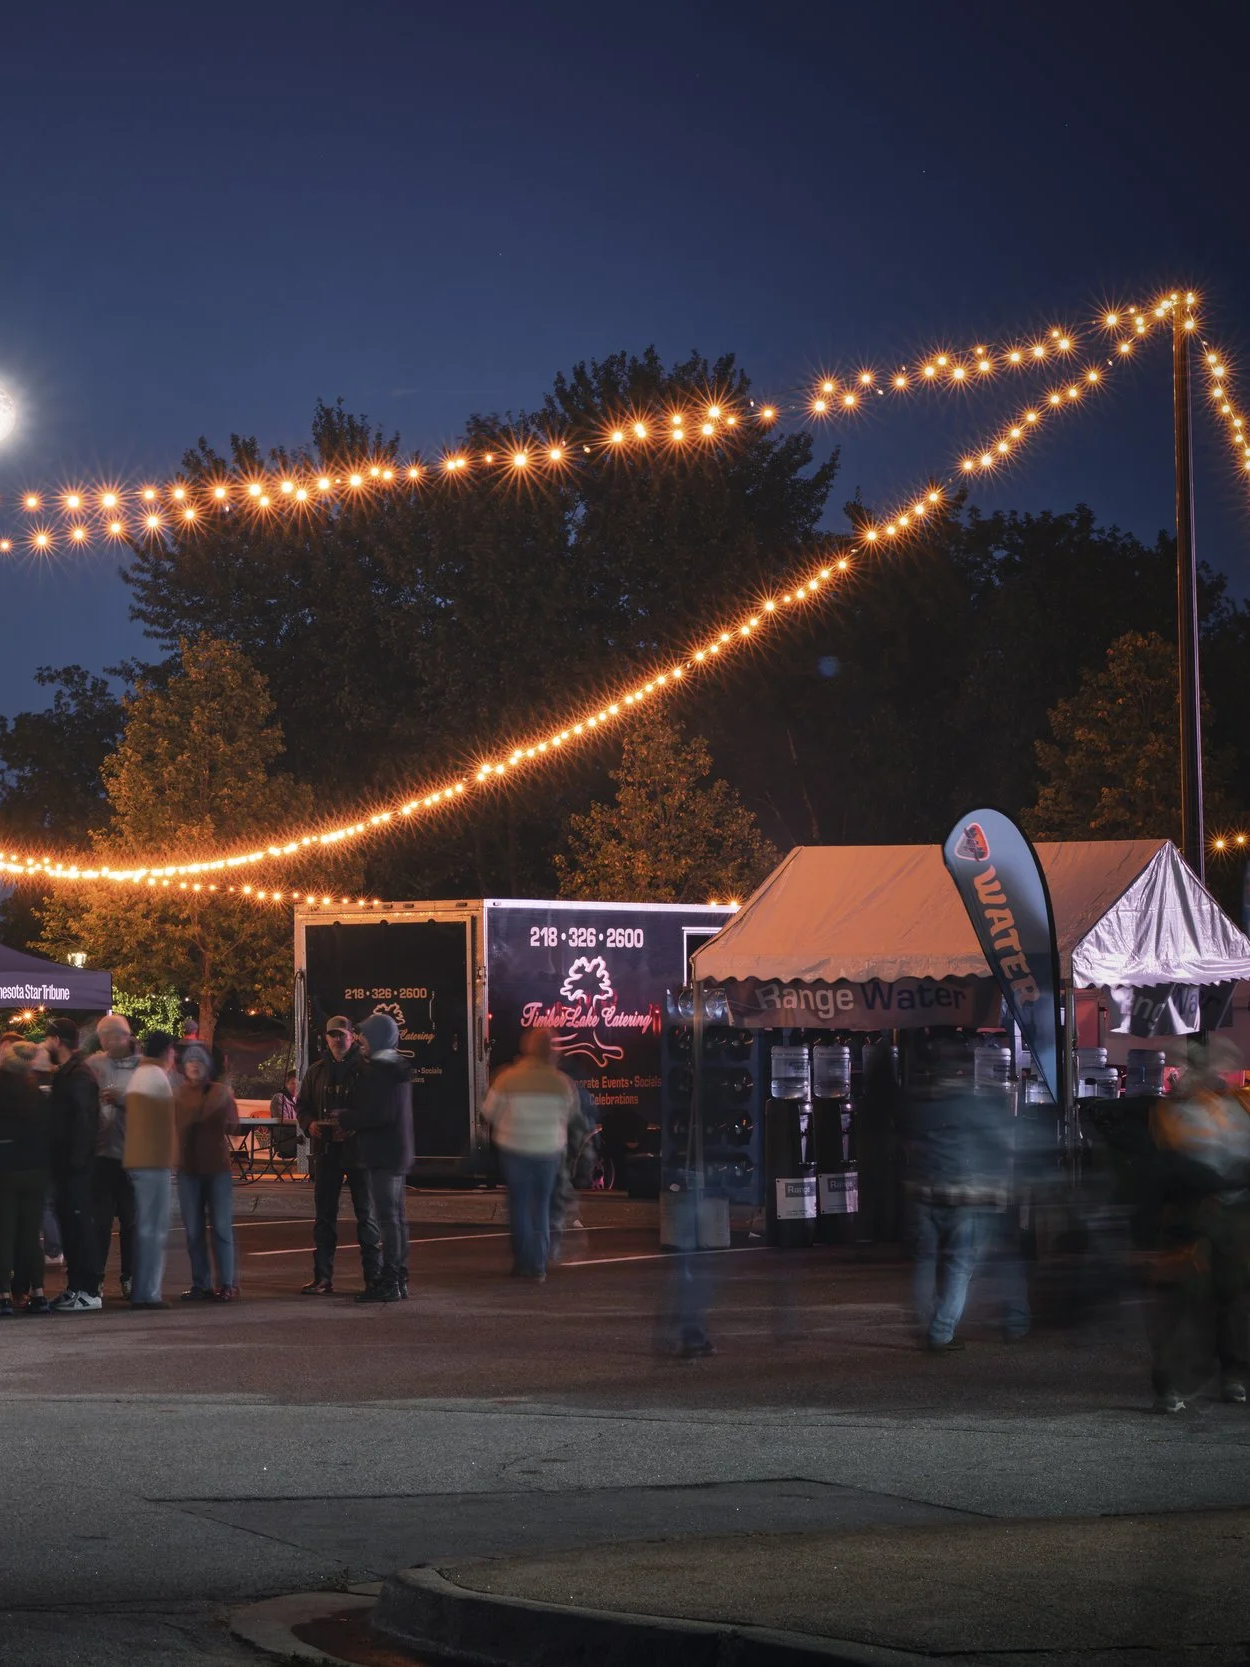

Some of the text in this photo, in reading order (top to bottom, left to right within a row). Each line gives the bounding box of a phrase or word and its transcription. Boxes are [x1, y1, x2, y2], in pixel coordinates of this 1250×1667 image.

[973, 864, 1041, 1009] WATER
[755, 982, 967, 1019] Range Water
[601, 1006, 653, 1034] Catering
[601, 1076, 629, 1089] Events
[634, 1076, 662, 1088] Socials
[589, 1092, 638, 1105] Celebrations
